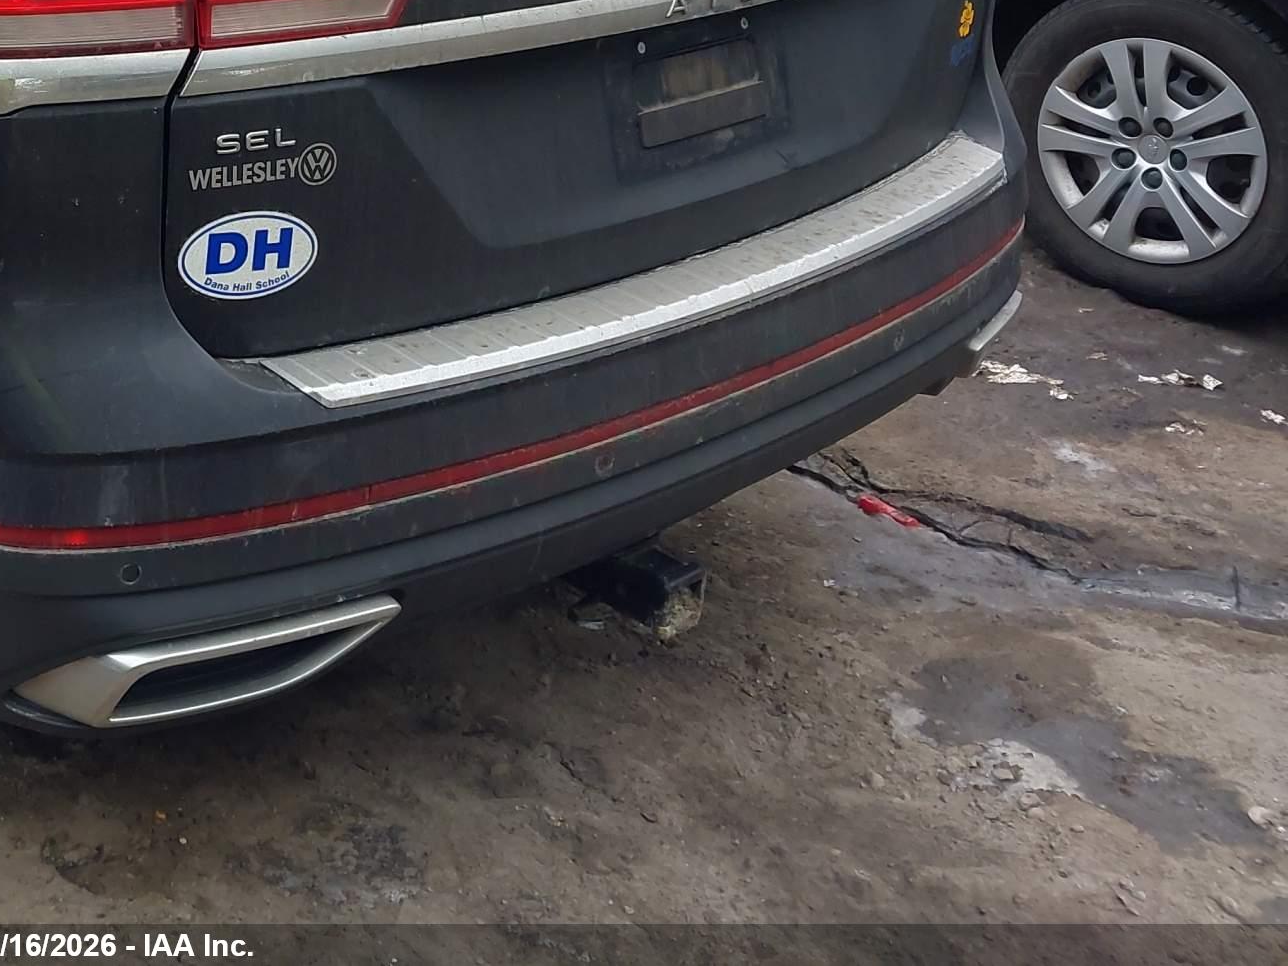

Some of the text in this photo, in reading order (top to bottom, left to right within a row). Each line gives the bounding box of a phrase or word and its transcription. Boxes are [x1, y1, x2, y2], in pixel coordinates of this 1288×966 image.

[216, 128, 296, 154] SEL
[188, 157, 299, 191] WELLESLEY
[205, 227, 294, 275] DH
[204, 270, 290, 292] Dana Hall School
